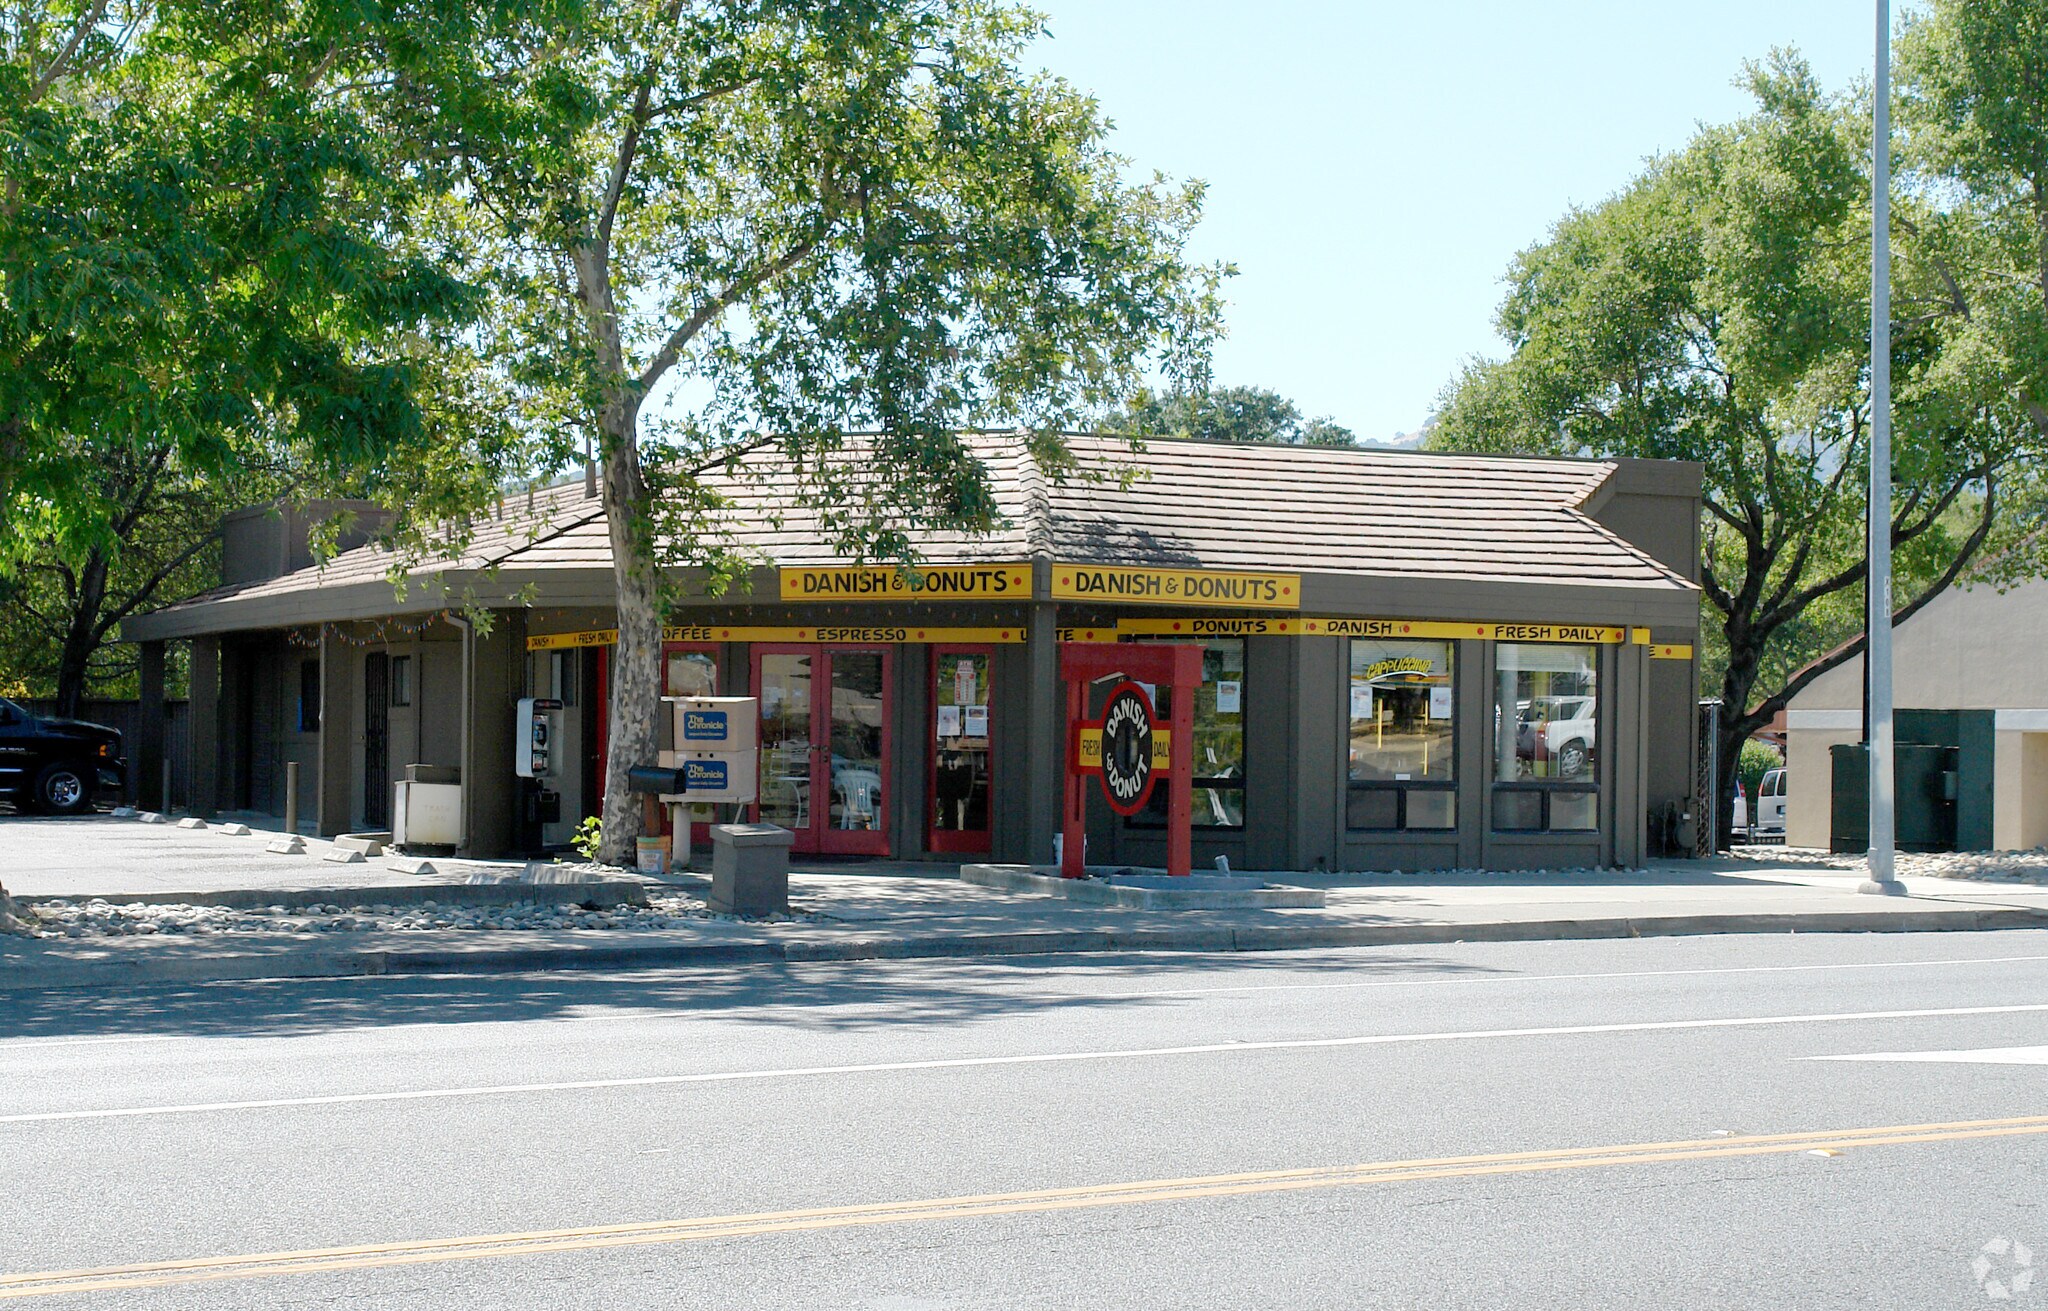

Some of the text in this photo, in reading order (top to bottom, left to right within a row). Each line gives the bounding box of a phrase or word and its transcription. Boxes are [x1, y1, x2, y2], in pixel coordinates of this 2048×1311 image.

[803, 573, 887, 593] DANISH
[891, 574, 903, 590] &
[1075, 572, 1277, 601] DANISH & DONUTS
[1192, 620, 1267, 633] DONUTS
[1327, 620, 1392, 635] DANISH
[1494, 625, 1605, 641] FRESH DAILY
[578, 631, 613, 644] FRESH DAILY
[662, 628, 712, 640] OFFEE
[816, 628, 907, 641] ESPRESSO
[531, 638, 549, 647] DANISH
[1366, 656, 1432, 679] CAPPUCCINO
[688, 714, 704, 723] The
[1106, 697, 1149, 739] DANISH
[687, 721, 725, 730] Chronicle
[1082, 739, 1101, 756] FRESH
[688, 763, 704, 772] The
[687, 770, 725, 779] Chronicle
[1106, 752, 1148, 799] & DONUT
